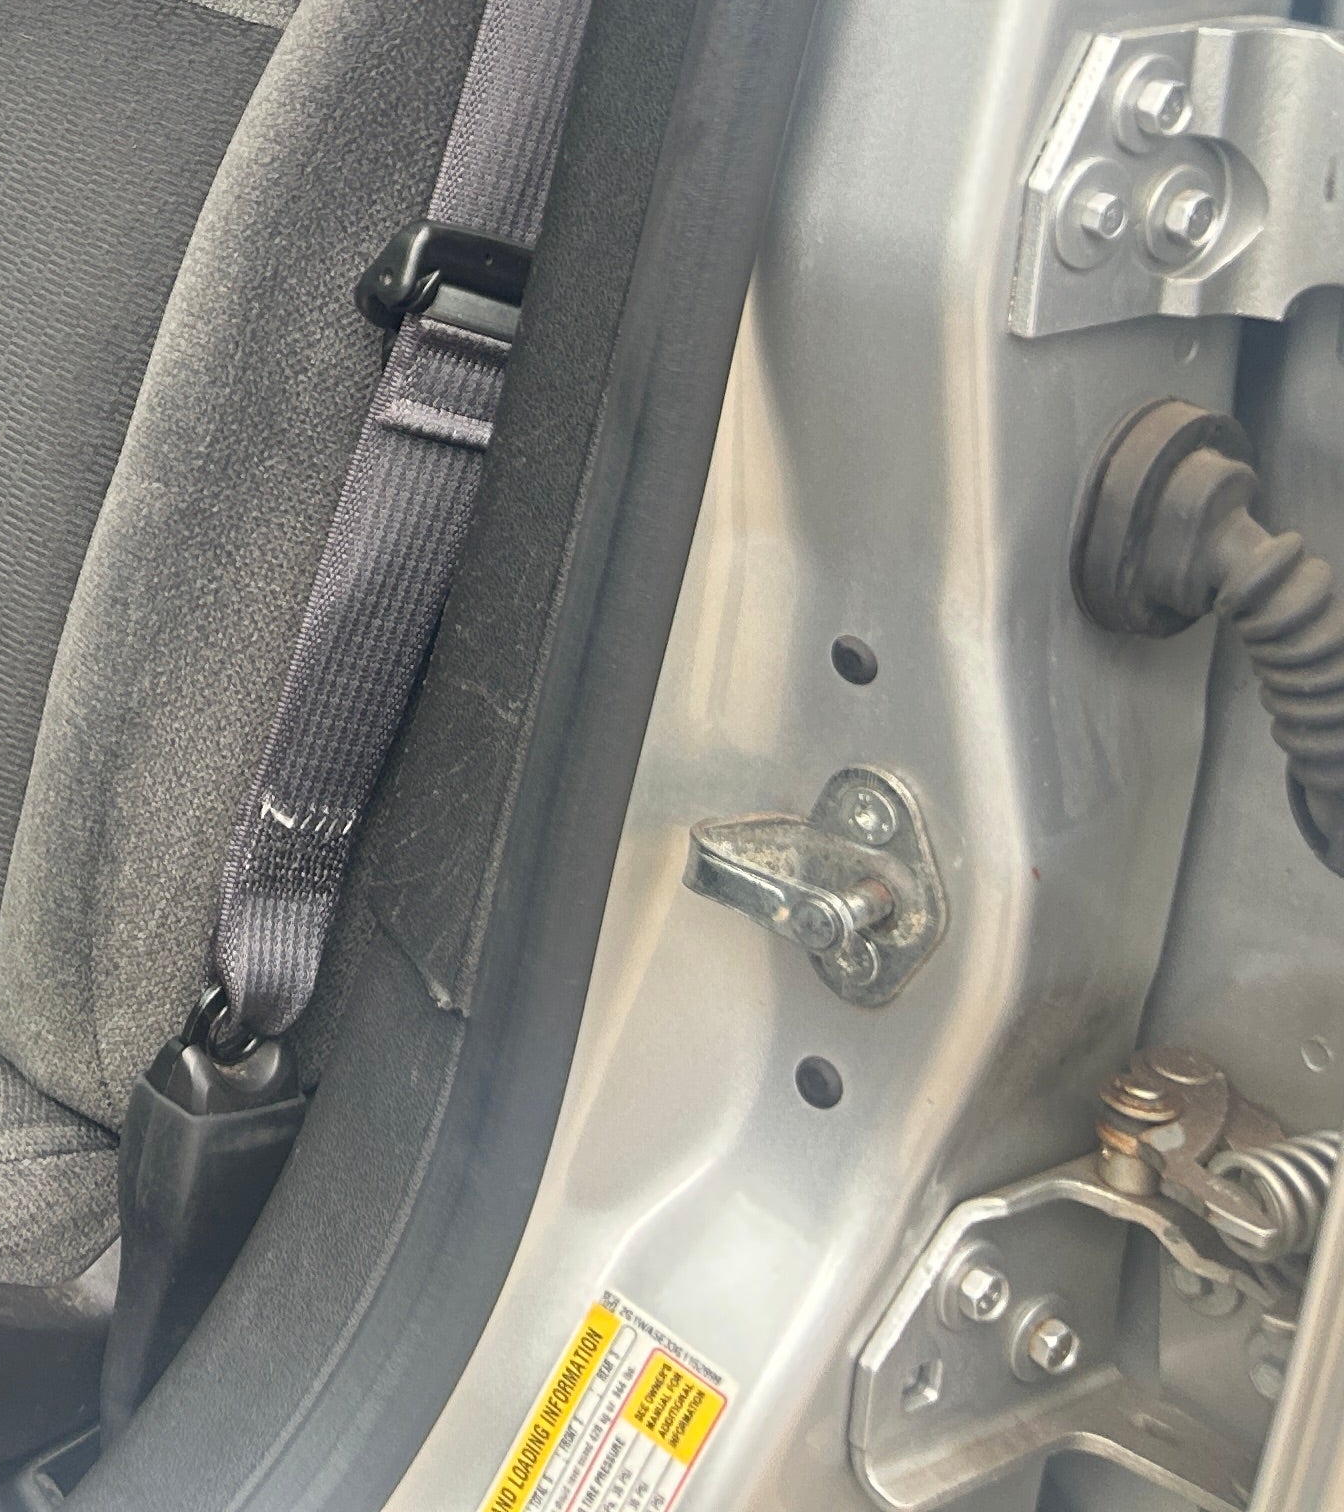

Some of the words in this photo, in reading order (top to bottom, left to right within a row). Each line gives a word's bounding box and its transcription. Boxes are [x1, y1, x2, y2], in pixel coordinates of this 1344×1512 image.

[596, 1358, 615, 1381] REAR
[634, 1402, 650, 1422] SEE
[644, 1363, 672, 1403] OWNER'S
[508, 1423, 551, 1489] LOADING
[539, 1325, 604, 1426] INFORMATION
[647, 1393, 672, 1430] MANUAL
[667, 1372, 683, 1392] FOR
[659, 1382, 695, 1438] ADDITIONAL
[669, 1389, 706, 1448] INFORMATION
[559, 1424, 578, 1452] FRONT
[582, 1485, 598, 1508] TIRE
[594, 1435, 625, 1486] PRESSURE
